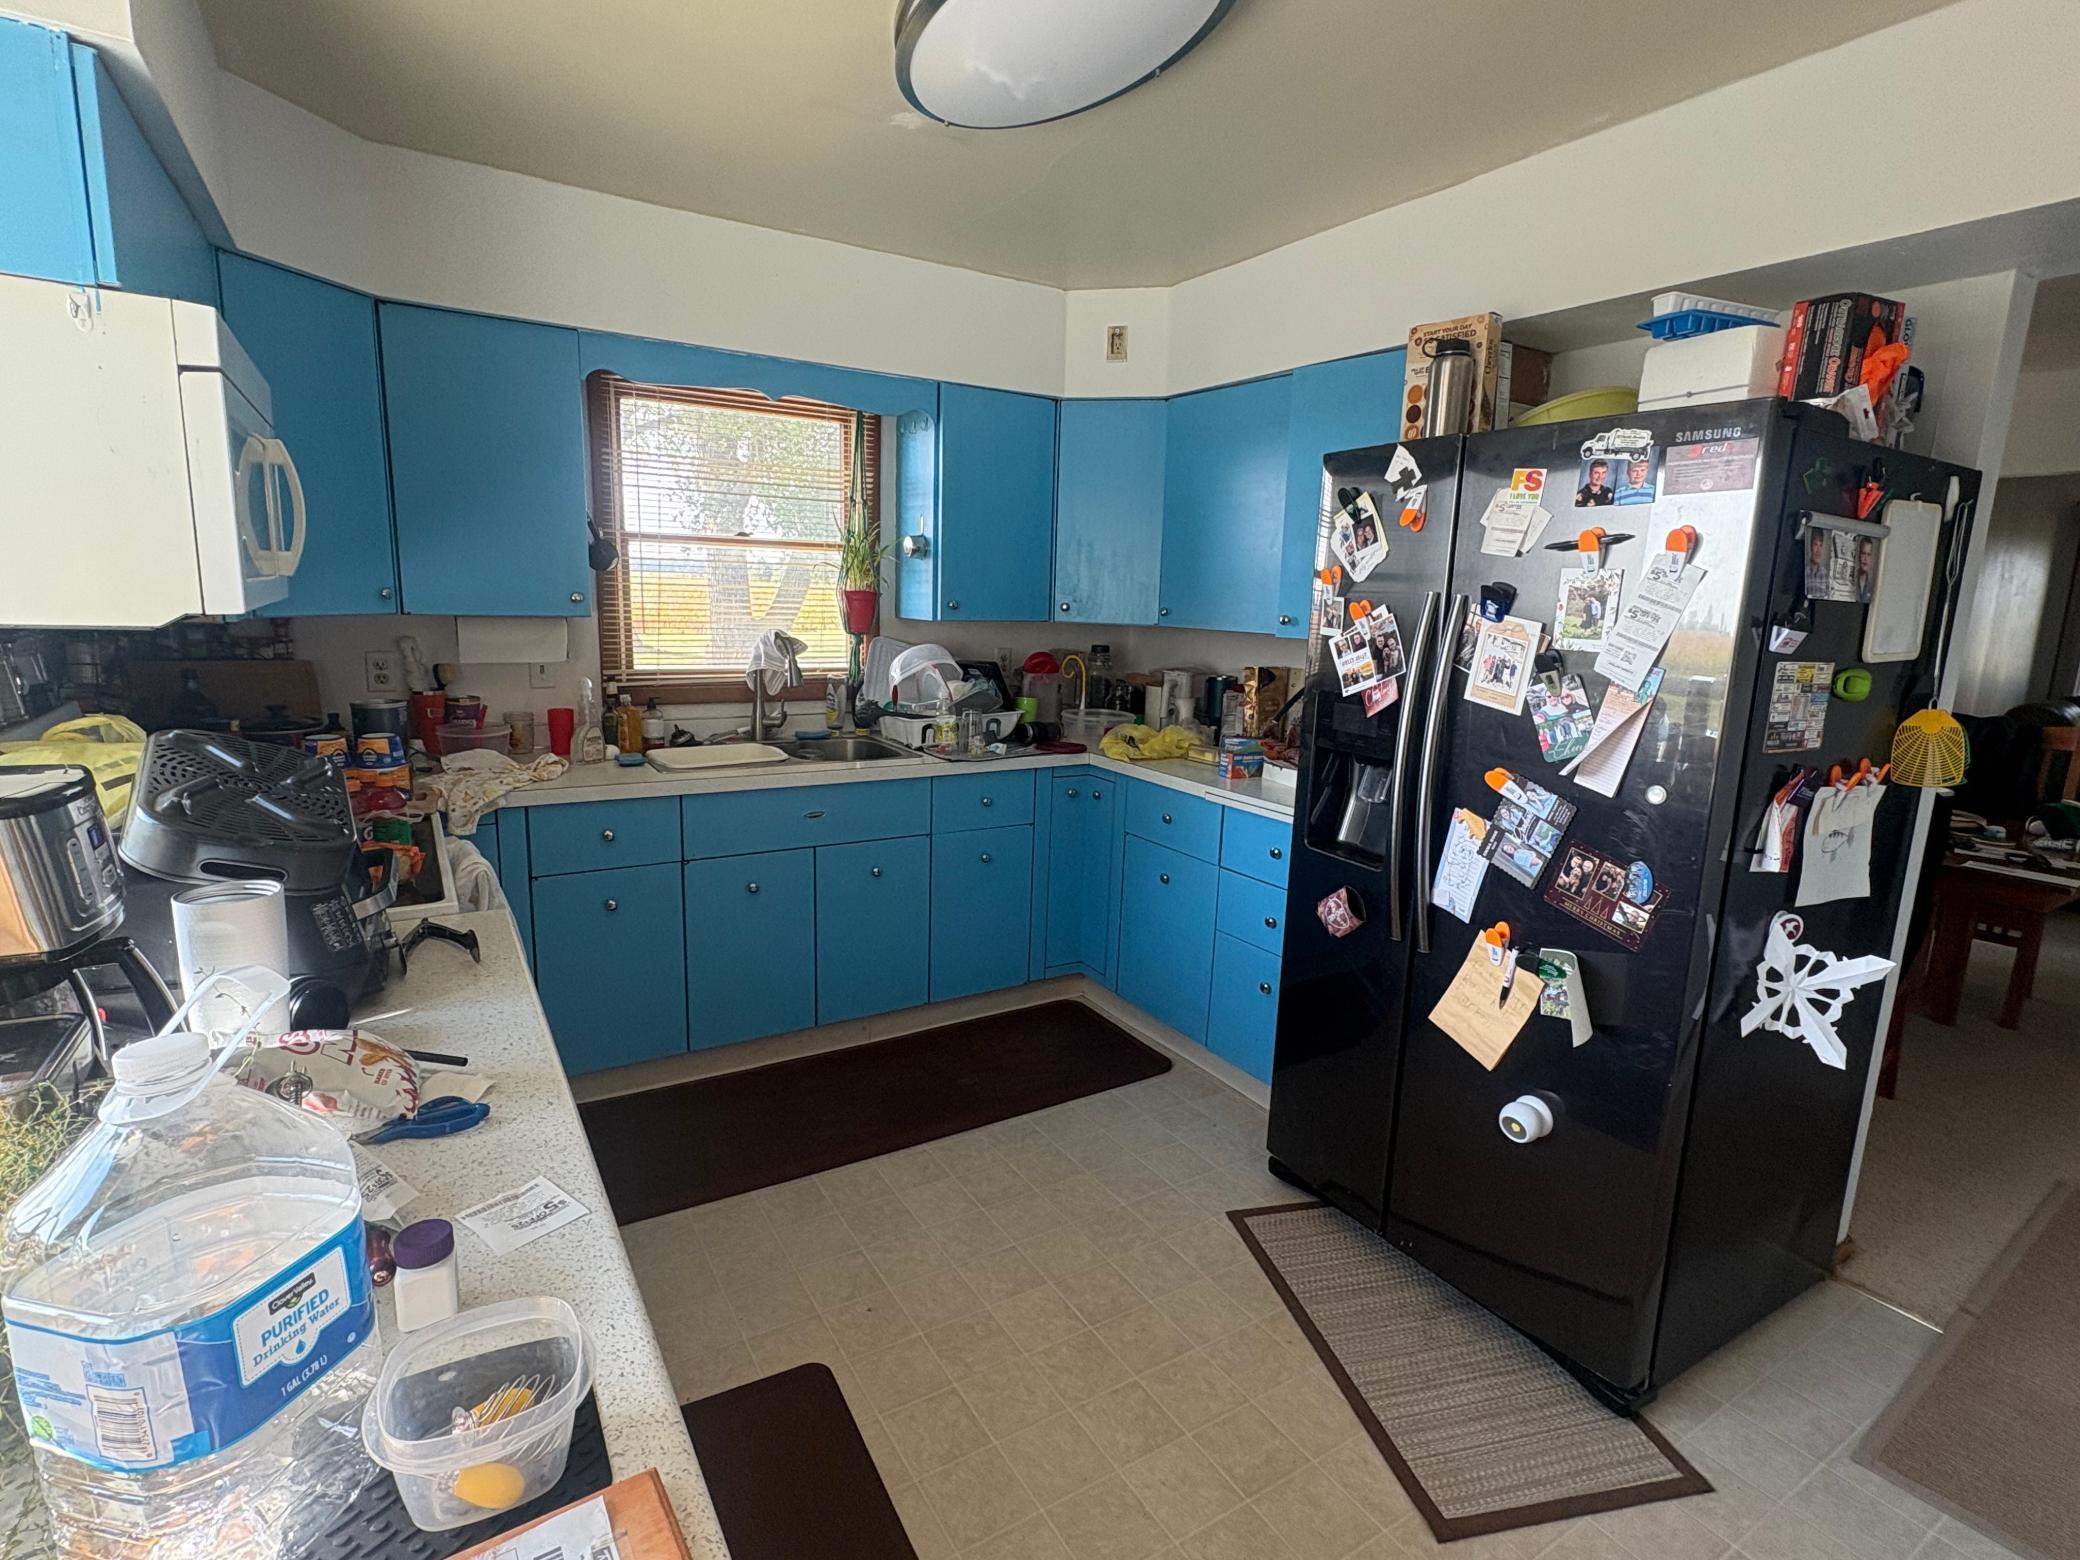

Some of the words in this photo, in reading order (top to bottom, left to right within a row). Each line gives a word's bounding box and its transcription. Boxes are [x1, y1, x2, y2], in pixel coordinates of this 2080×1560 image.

[1423, 328, 1441, 337] START
[1442, 325, 1459, 334] YOUR
[1675, 426, 1742, 443] SAMSUNG
[1701, 442, 1729, 455] red
[1511, 470, 1544, 491] FS
[1564, 900, 1585, 916] MERRY
[1585, 912, 1621, 936] CHRISTMAS
[260, 1288, 329, 1347] PURIFIED
[252, 1324, 307, 1367] Drinking
[309, 1297, 340, 1325] Water
[286, 1376, 301, 1393] GAL
[302, 1361, 320, 1382] (3.78
[319, 1354, 328, 1368] L)
